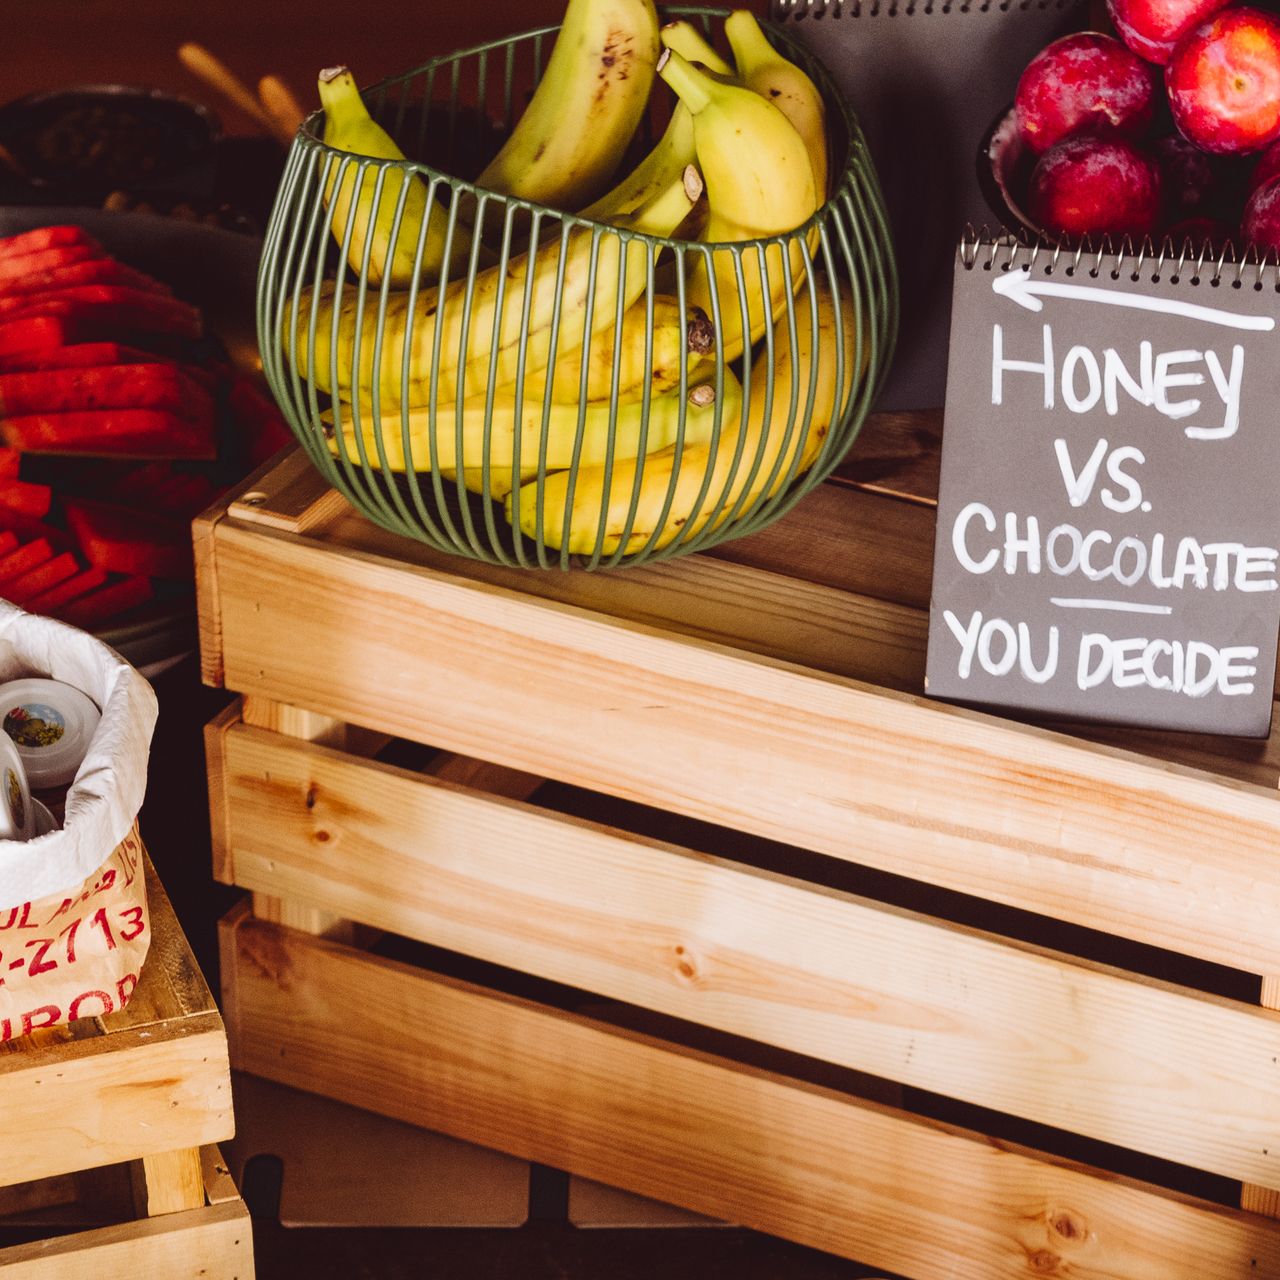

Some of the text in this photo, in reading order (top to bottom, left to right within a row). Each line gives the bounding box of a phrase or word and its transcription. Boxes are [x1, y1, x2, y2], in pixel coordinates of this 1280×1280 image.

[991, 323, 1245, 440] HONEY
[1053, 438, 1153, 513] VS.
[951, 502, 1280, 591] CHOCOLATE
[943, 610, 1260, 699] YOU DECIDE
